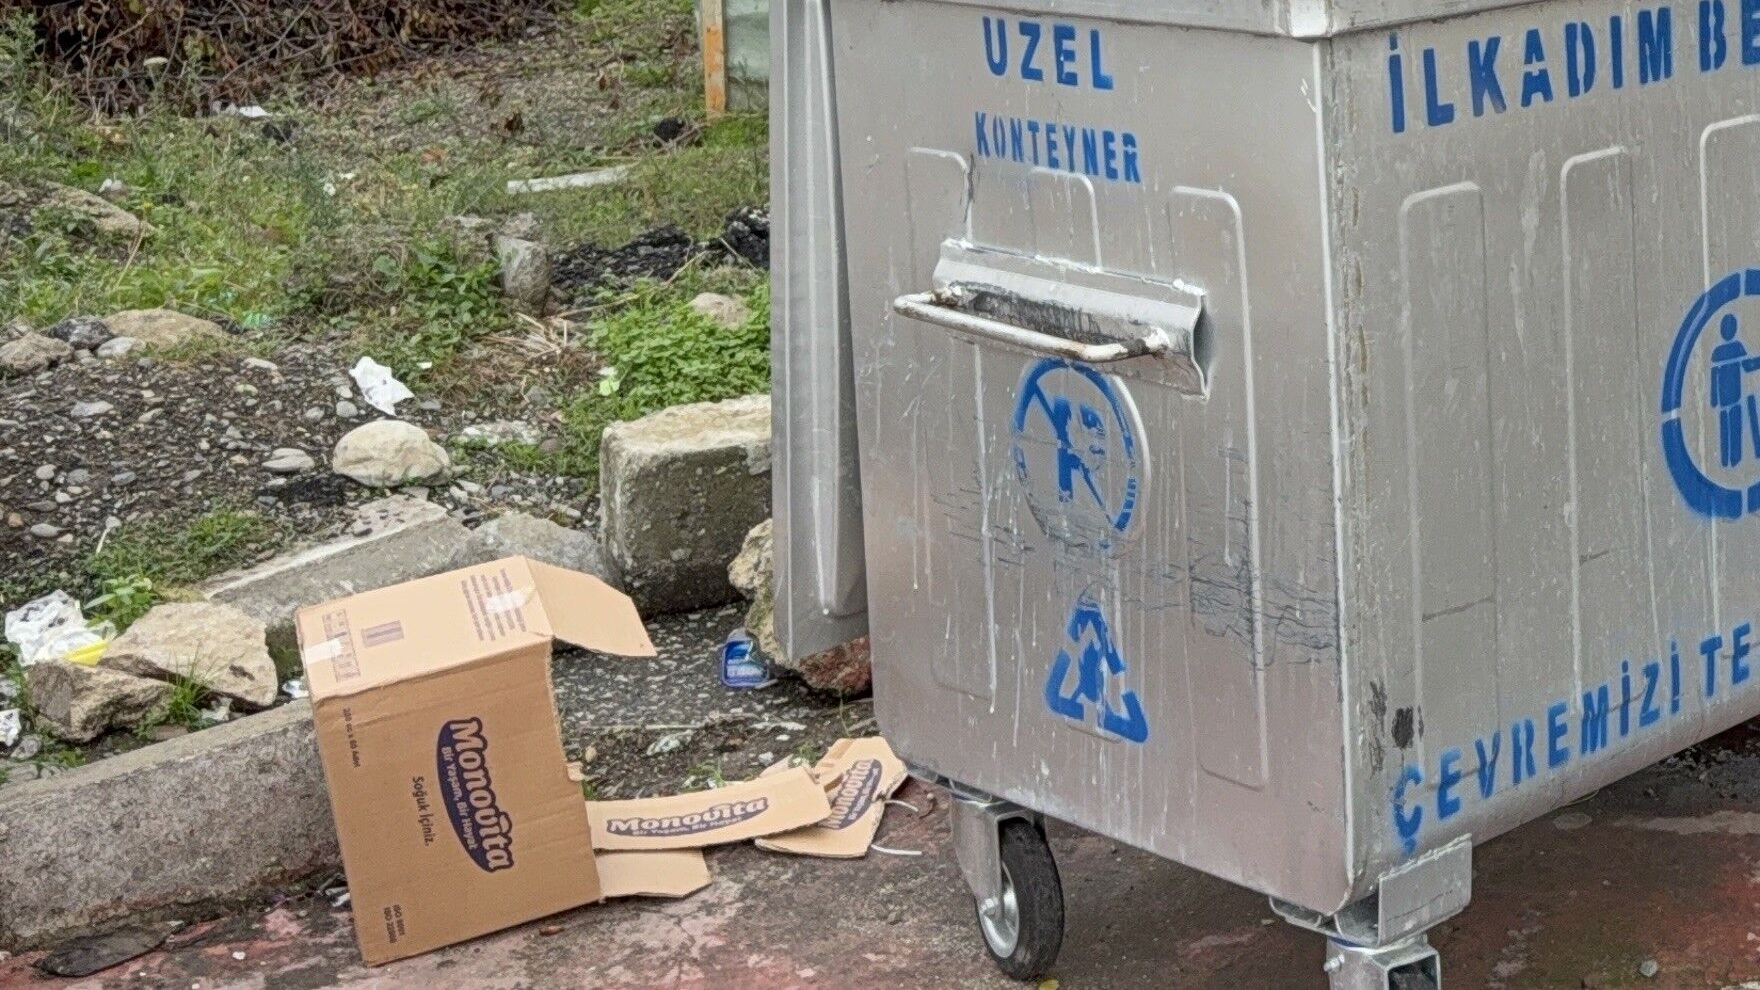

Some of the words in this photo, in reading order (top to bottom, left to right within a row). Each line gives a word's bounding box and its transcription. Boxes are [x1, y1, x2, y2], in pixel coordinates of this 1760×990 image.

[982, 16, 1114, 90] UZEL
[1388, 6, 1674, 133] İLKADIM
[975, 111, 1141, 183] KONTEYNER
[441, 746, 452, 762] Bir
[1391, 641, 1682, 855] ÇEVREMİZİ
[411, 776, 430, 812] Soğuk
[446, 764, 463, 801] Yaşam,
[456, 801, 470, 818] Bir
[461, 818, 479, 850] Hayat
